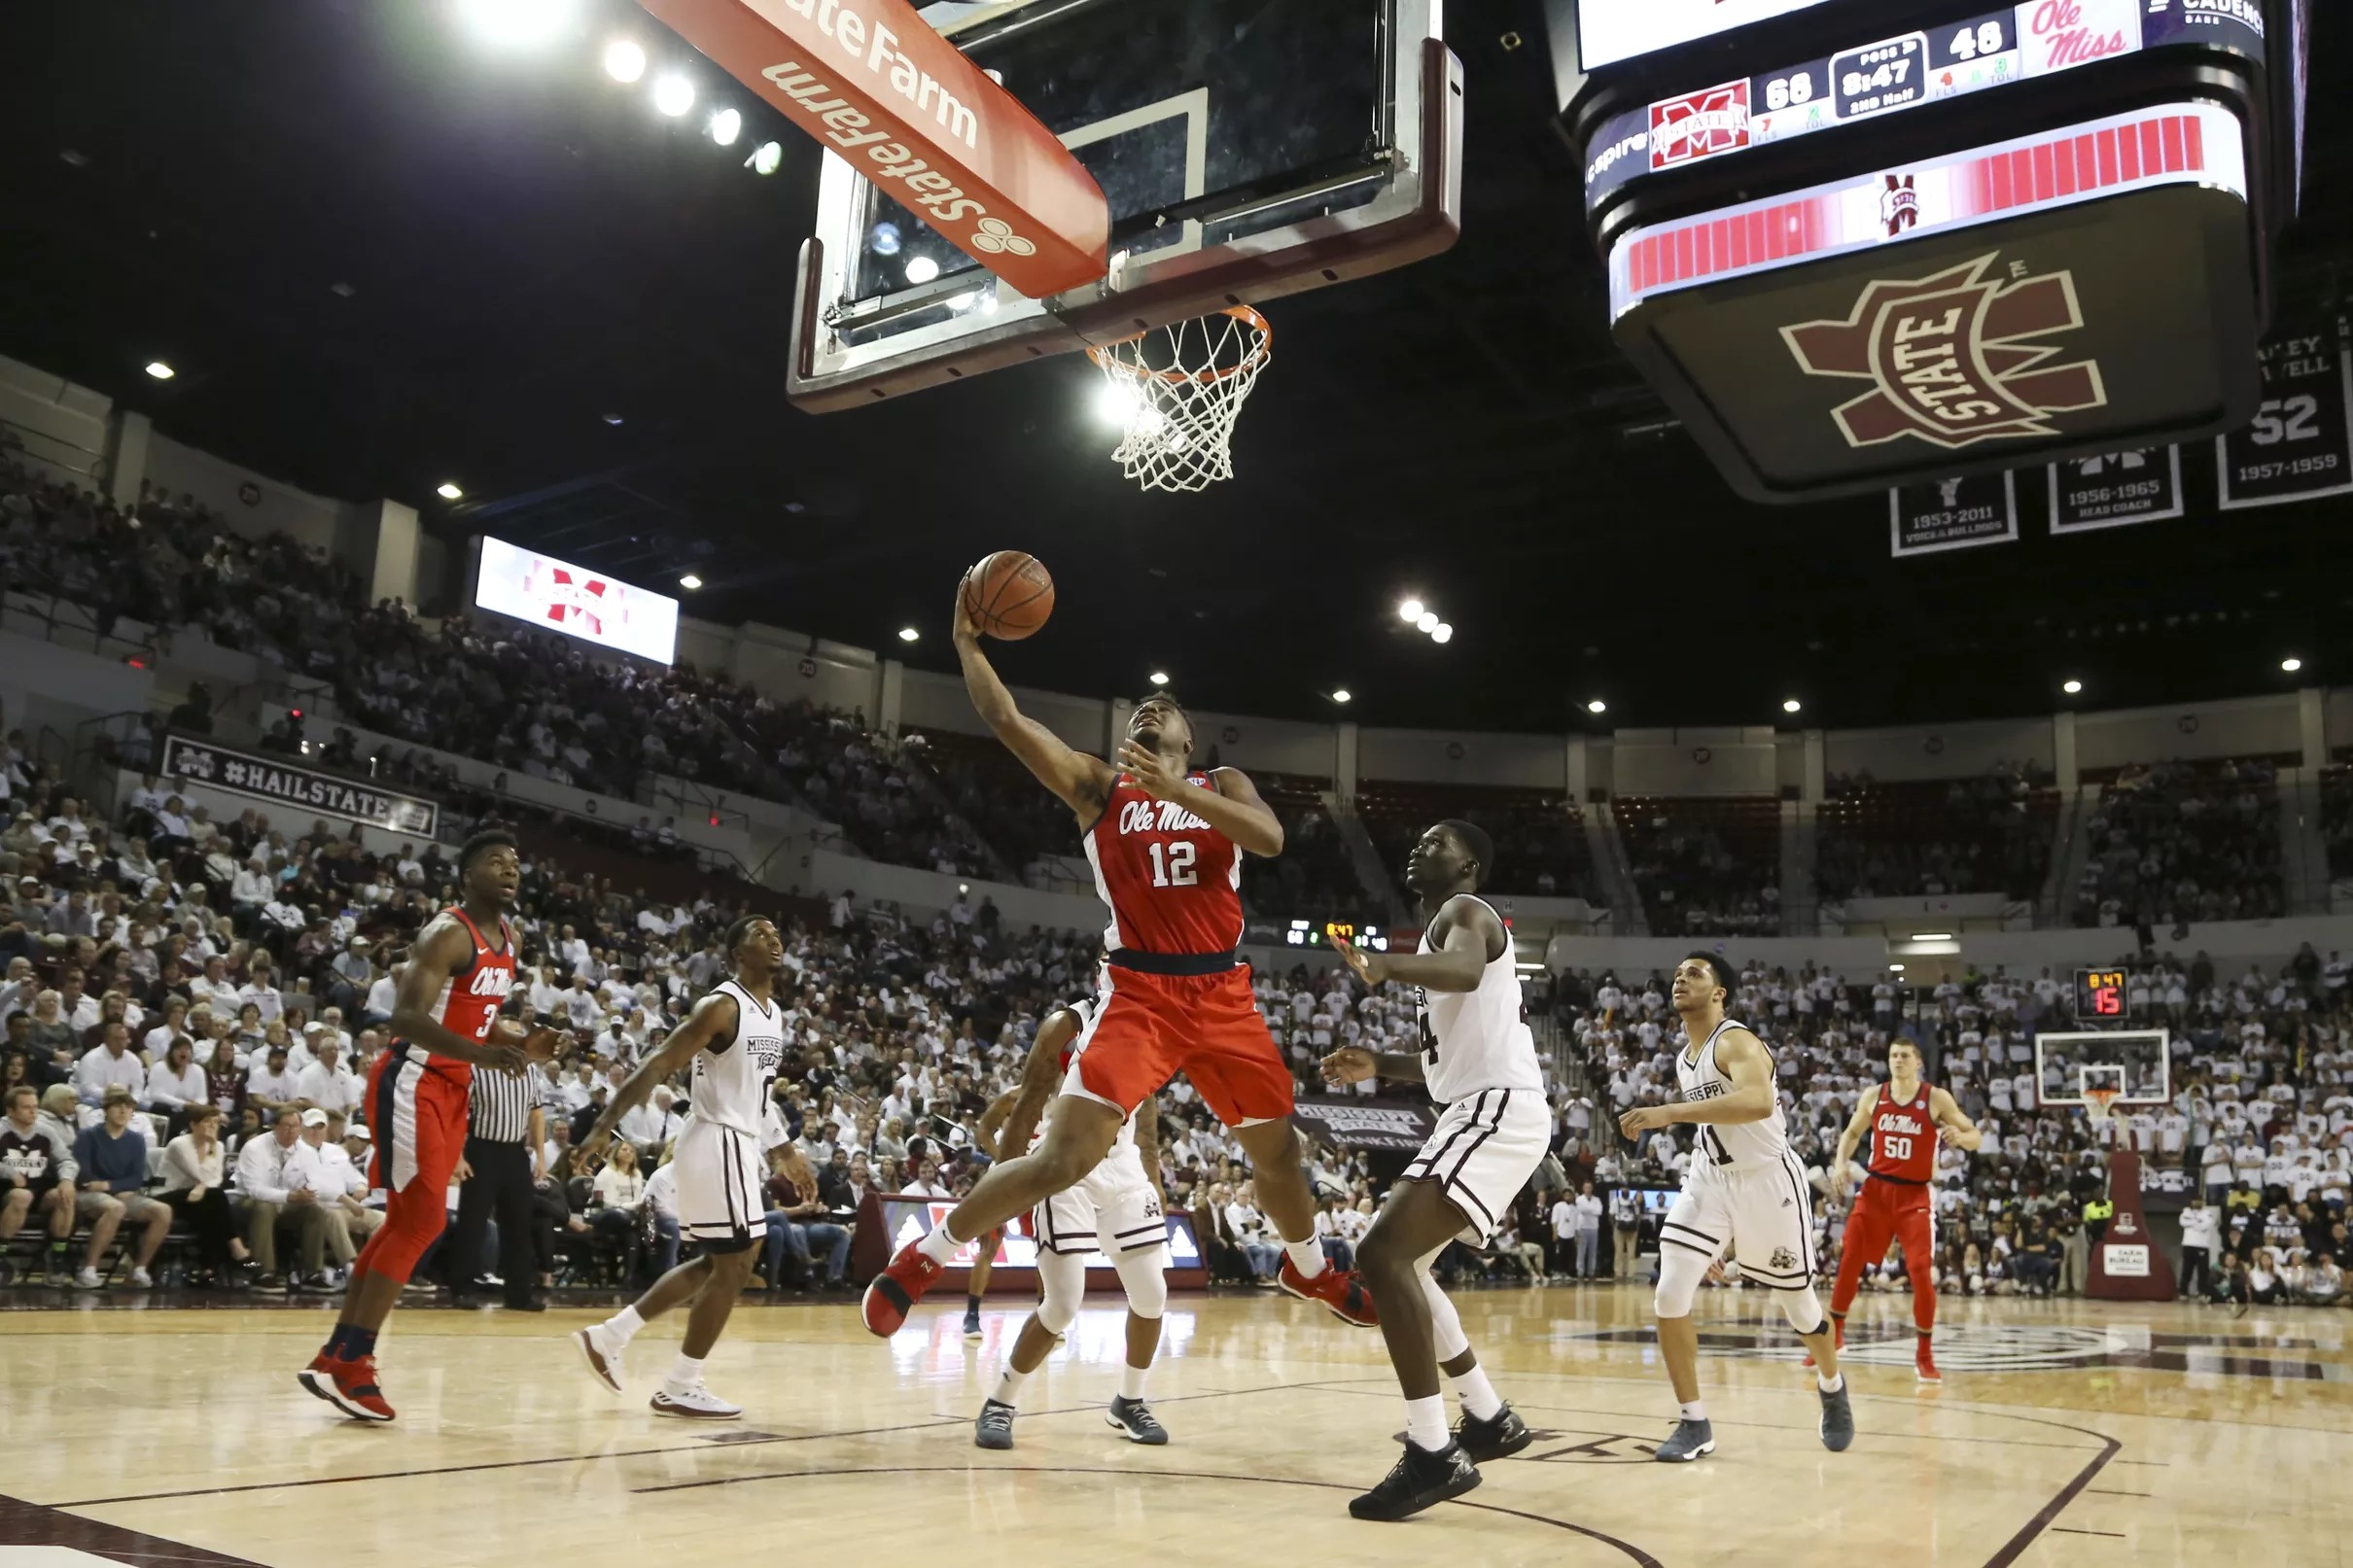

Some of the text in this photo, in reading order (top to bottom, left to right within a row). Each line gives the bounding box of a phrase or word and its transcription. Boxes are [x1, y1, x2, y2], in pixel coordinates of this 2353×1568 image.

[2031, 0, 2082, 35] Ole
[2185, 15, 2220, 25] BANK
[1949, 20, 2003, 60] 48
[2046, 27, 2126, 69] Miss
[1843, 58, 1911, 96] 8:47
[1850, 87, 1914, 115] 2ND Half
[761, 61, 986, 222] StateFarm
[1668, 113, 1724, 135] STATE
[2008, 259, 2029, 279] TM
[1893, 307, 2002, 421] STATE
[2251, 395, 2320, 446] 52
[2239, 453, 2338, 483] 1957-1959
[2068, 479, 2161, 506] 1956-1965
[1913, 505, 1993, 530] 1953-2011
[225, 759, 389, 820] #HAILSTATE
[1119, 800, 1155, 835] Ole
[1148, 841, 1198, 888] 12
[2095, 987, 2120, 1014] 15
[475, 1003, 498, 1038] 3
[1878, 1113, 1922, 1135] Ole Miss
[1884, 1135, 1912, 1161] 50
